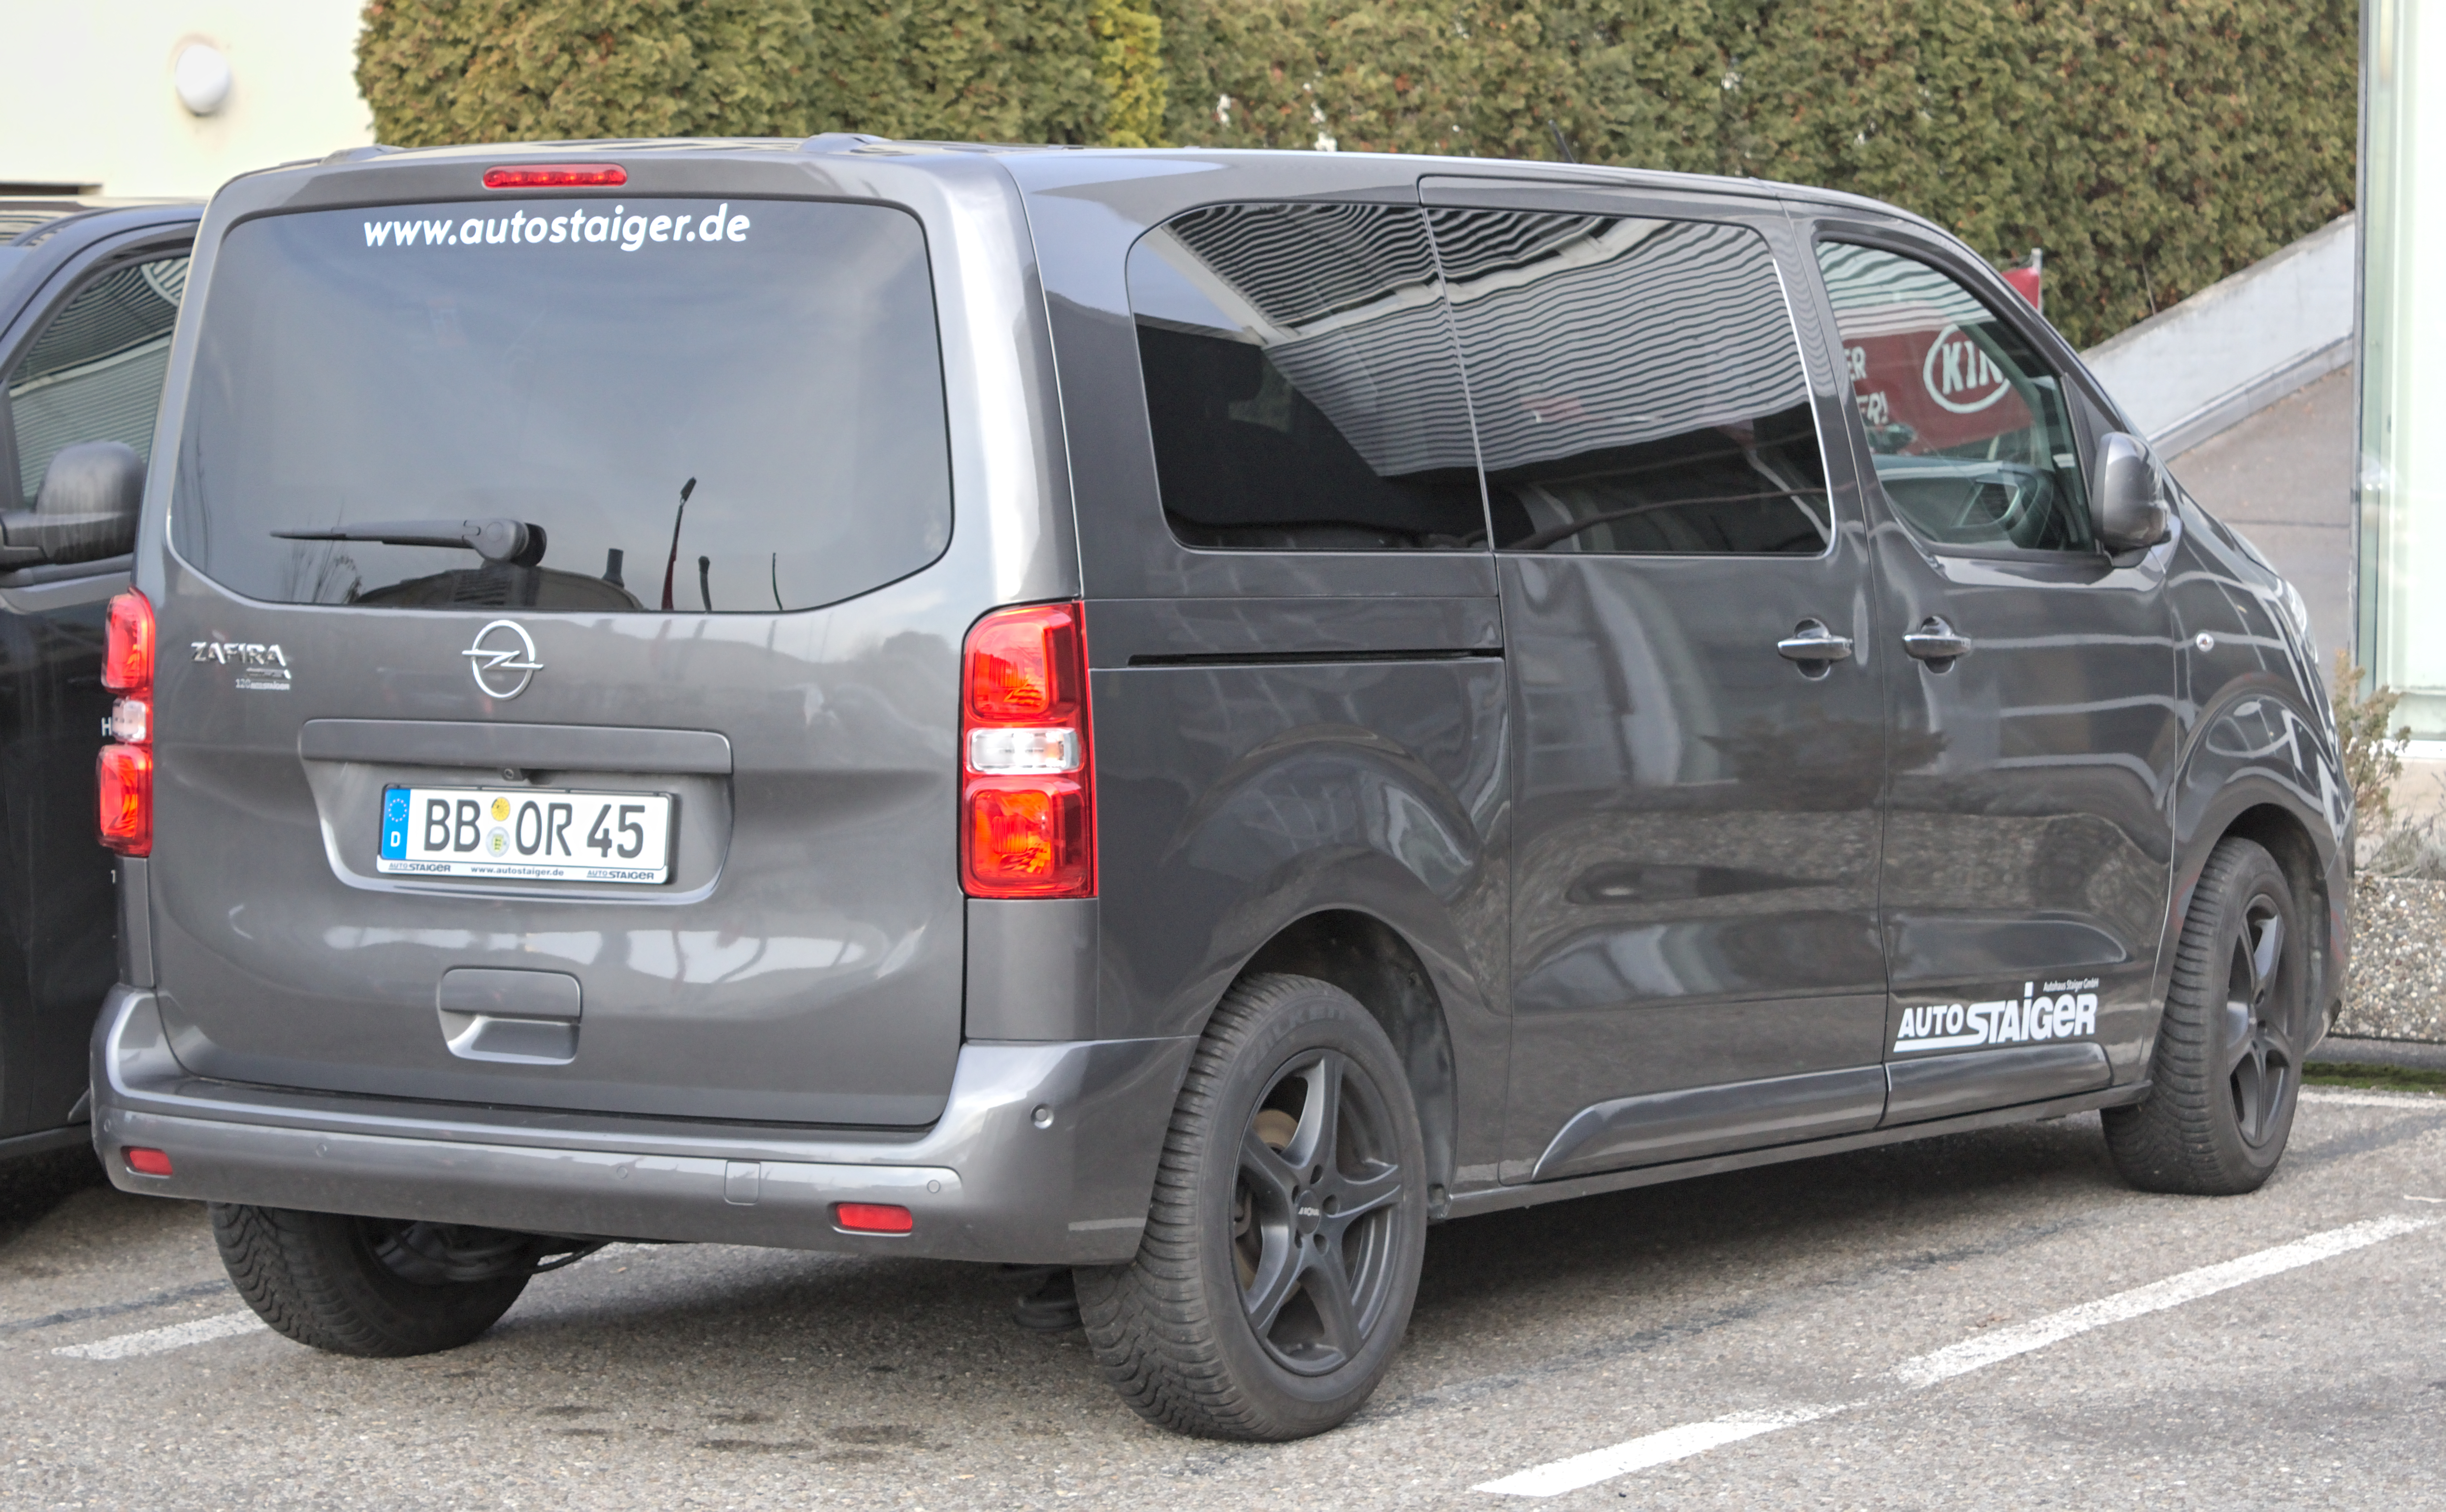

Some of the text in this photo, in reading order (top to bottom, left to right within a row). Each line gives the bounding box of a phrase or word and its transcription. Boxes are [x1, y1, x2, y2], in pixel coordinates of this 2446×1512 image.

[364, 203, 750, 252] www.autostaiger.de
[191, 642, 286, 666] ZAFIRA
[390, 832, 401, 847] D
[424, 799, 645, 858] BB OR 45
[471, 867, 564, 877] www.autostaiger.de
[1897, 1003, 1964, 1038] AUTO
